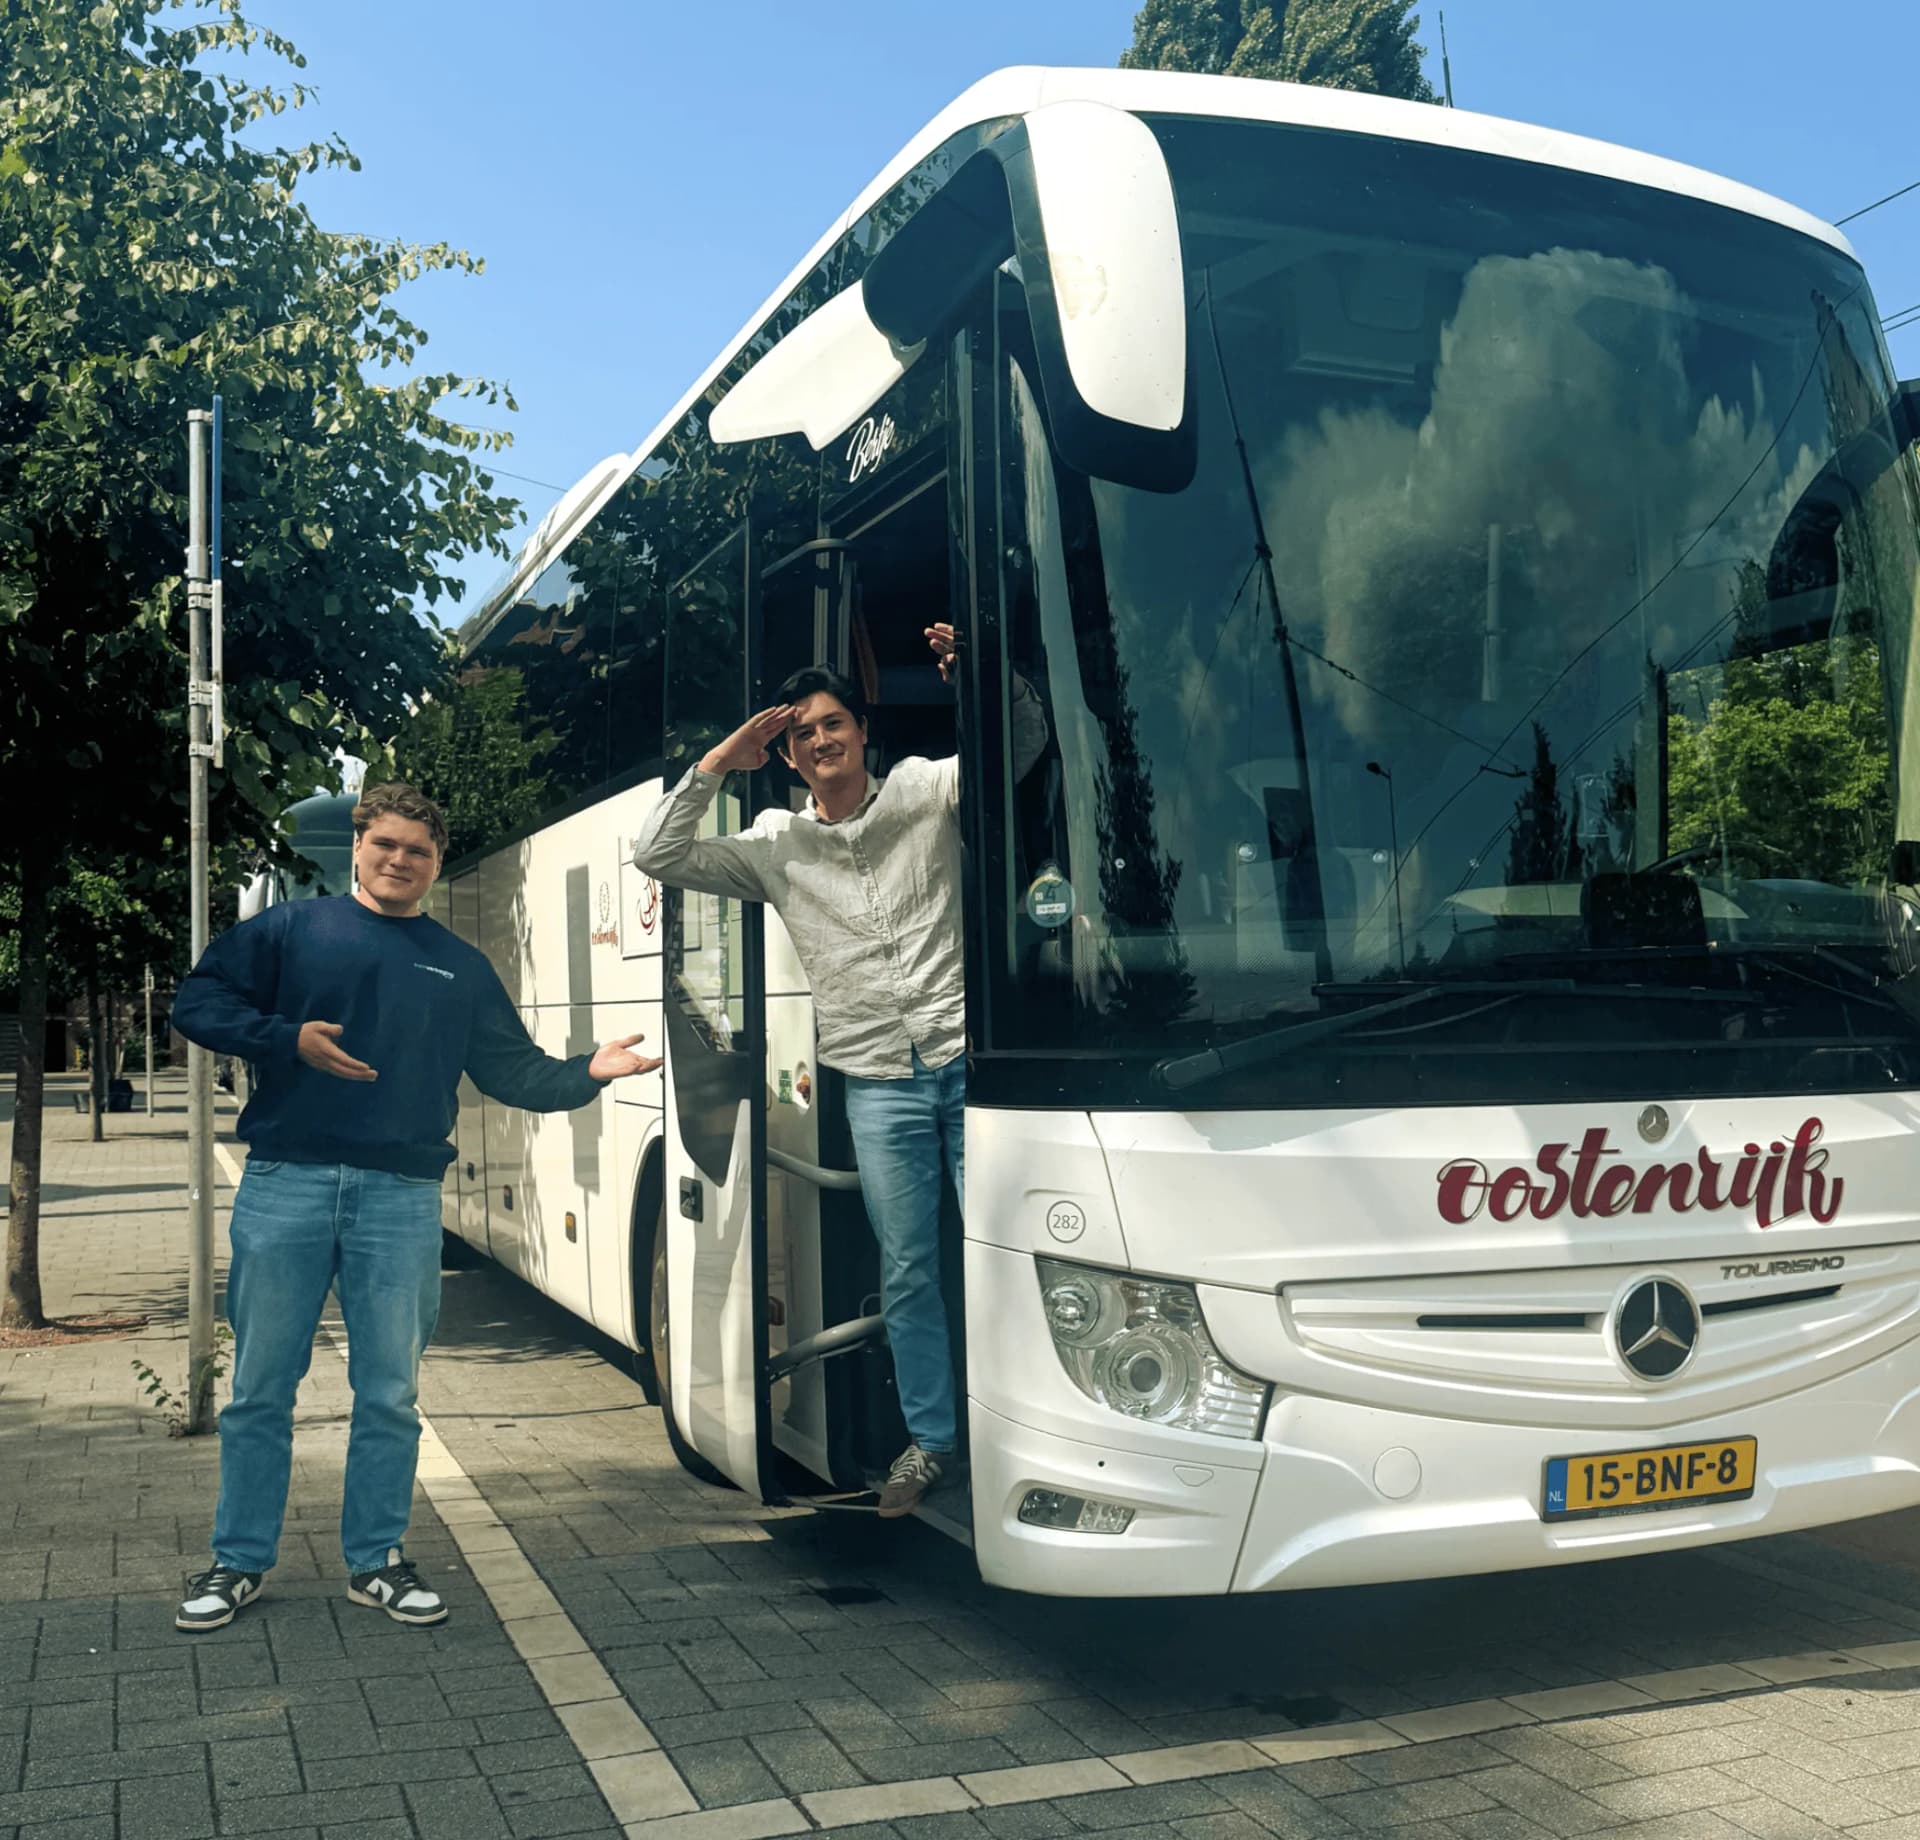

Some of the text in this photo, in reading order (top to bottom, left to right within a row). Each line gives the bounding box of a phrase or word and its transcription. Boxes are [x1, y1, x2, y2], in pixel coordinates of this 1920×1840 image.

[1052, 1214, 1079, 1230] 282
[1720, 1255, 1845, 1280] TOURISMO
[1583, 1447, 1738, 1502] 15-BNF-8
[1549, 1491, 1563, 1502] NL
